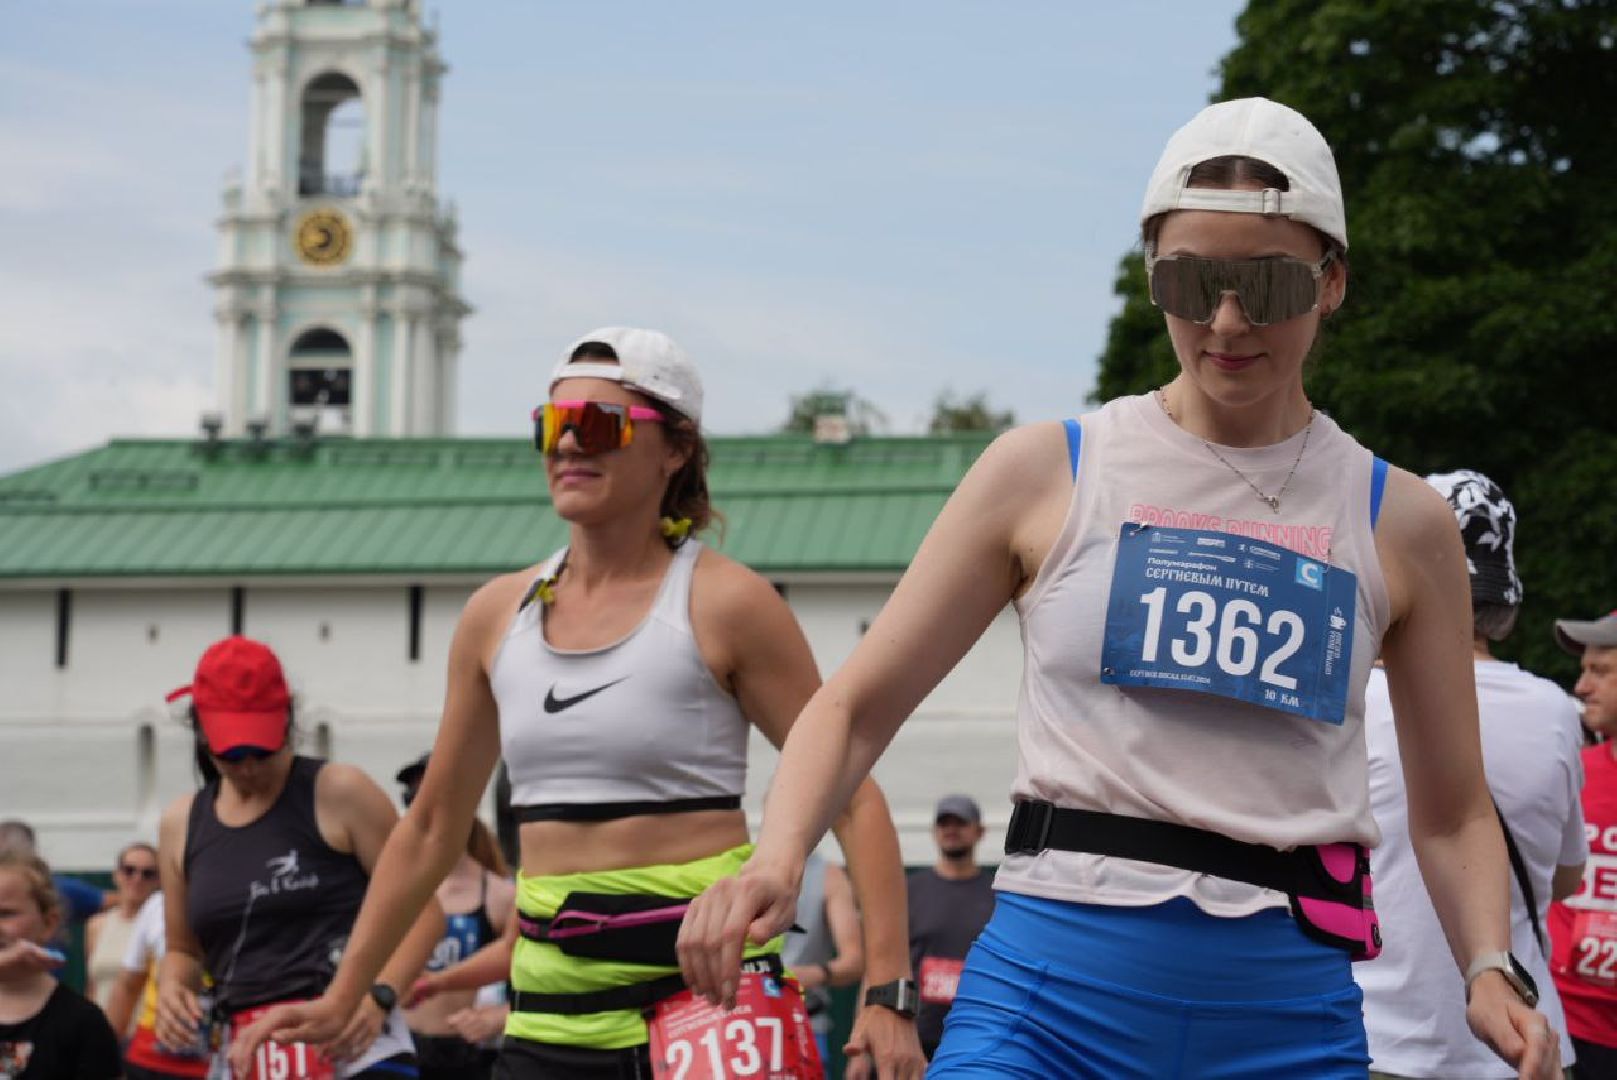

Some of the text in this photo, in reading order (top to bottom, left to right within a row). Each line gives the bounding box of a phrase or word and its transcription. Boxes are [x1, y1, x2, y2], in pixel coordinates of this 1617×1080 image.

[1140, 586, 1305, 690] 1362
[1264, 688, 1276, 701] 10
[666, 1017, 784, 1080] 2137
